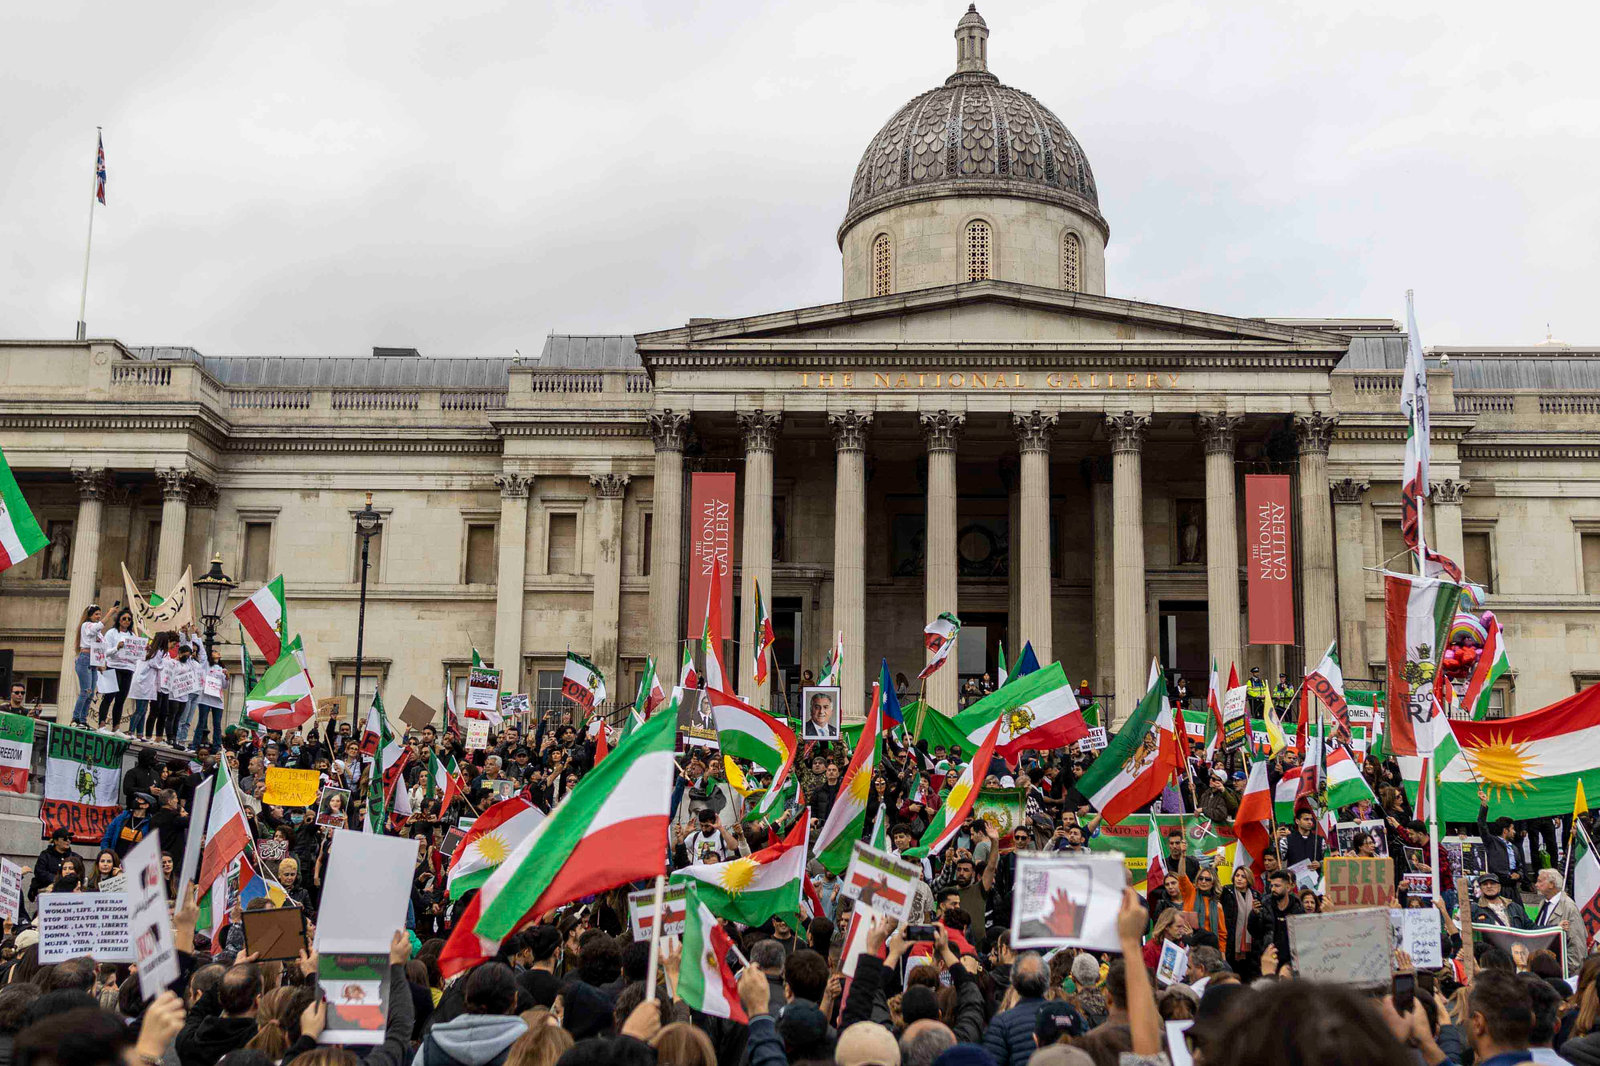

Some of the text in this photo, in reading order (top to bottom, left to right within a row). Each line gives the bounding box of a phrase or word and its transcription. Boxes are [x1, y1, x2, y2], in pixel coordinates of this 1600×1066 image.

[799, 371, 1181, 388] THE NATIONAL GALLERY
[702, 499, 714, 575] NATIONAL
[716, 499, 729, 577] GALLERY
[1259, 501, 1272, 580] NATIONAL
[1272, 502, 1287, 580] GALLERY
[1349, 709, 1370, 718] OMEN.
[50, 727, 128, 767] FREEDOM
[1105, 827, 1131, 835] NATO
[1330, 860, 1386, 885] FREE
[1330, 884, 1394, 906] IRAN
